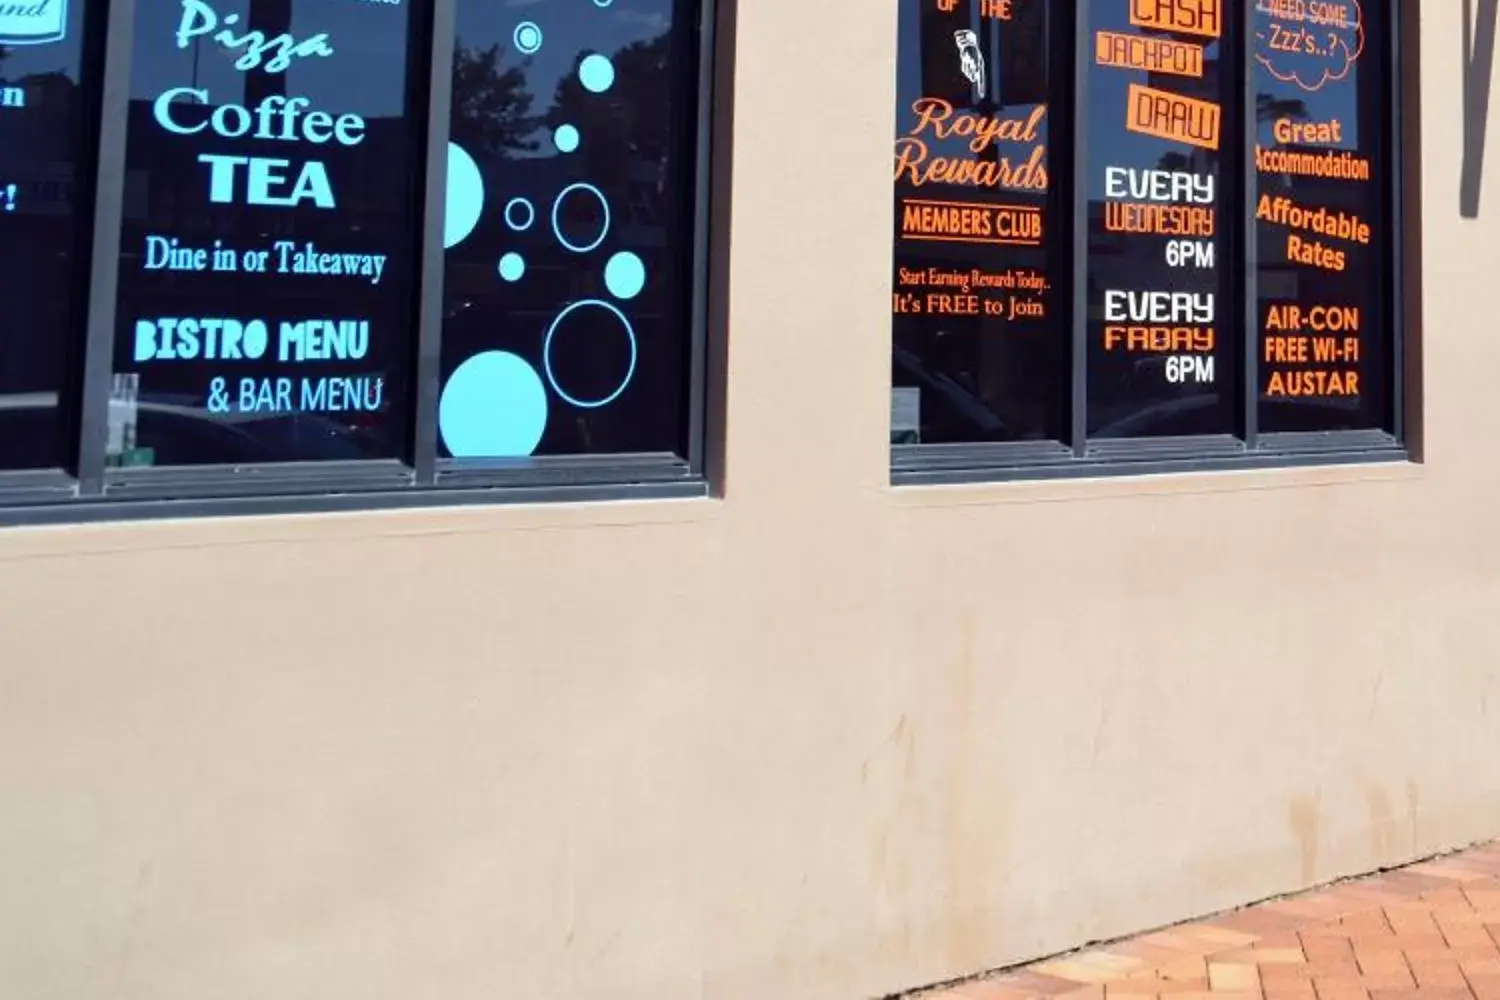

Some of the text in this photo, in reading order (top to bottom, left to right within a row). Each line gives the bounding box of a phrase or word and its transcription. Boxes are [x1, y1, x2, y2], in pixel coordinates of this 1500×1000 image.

[1309, 1, 1348, 29] SOME
[1096, 34, 1201, 73] JACKPOT
[153, 87, 366, 145] Coffee
[912, 97, 1048, 153] Royal
[1137, 92, 1215, 141] DRAW
[1274, 118, 1343, 144] Great
[895, 137, 1049, 190] Rewards
[1256, 144, 1370, 181] Accommodation
[198, 154, 336, 208] TEA
[1105, 167, 1214, 204] EVERY
[903, 205, 1042, 238] MEMBERS CLUB
[1105, 202, 1214, 236] WEDNESDAY
[1256, 194, 1371, 244] Affordable
[145, 236, 387, 284] Dine in or Takeaway
[1165, 240, 1214, 268] 6PM
[1287, 235, 1346, 271] Rates
[899, 267, 926, 285] Start
[928, 268, 970, 292] Earning
[972, 269, 1014, 289] Rewards
[893, 293, 1044, 321] It's FREE to Join
[1105, 289, 1214, 322] EVERY
[1265, 305, 1359, 331] AIR-CON
[134, 317, 369, 362] BISTRO MENU
[1265, 337, 1359, 362] FREE WI-FI
[1165, 354, 1214, 383] 6PM
[1267, 371, 1359, 396] AUSTAR
[207, 376, 383, 412] & BAR MENU
